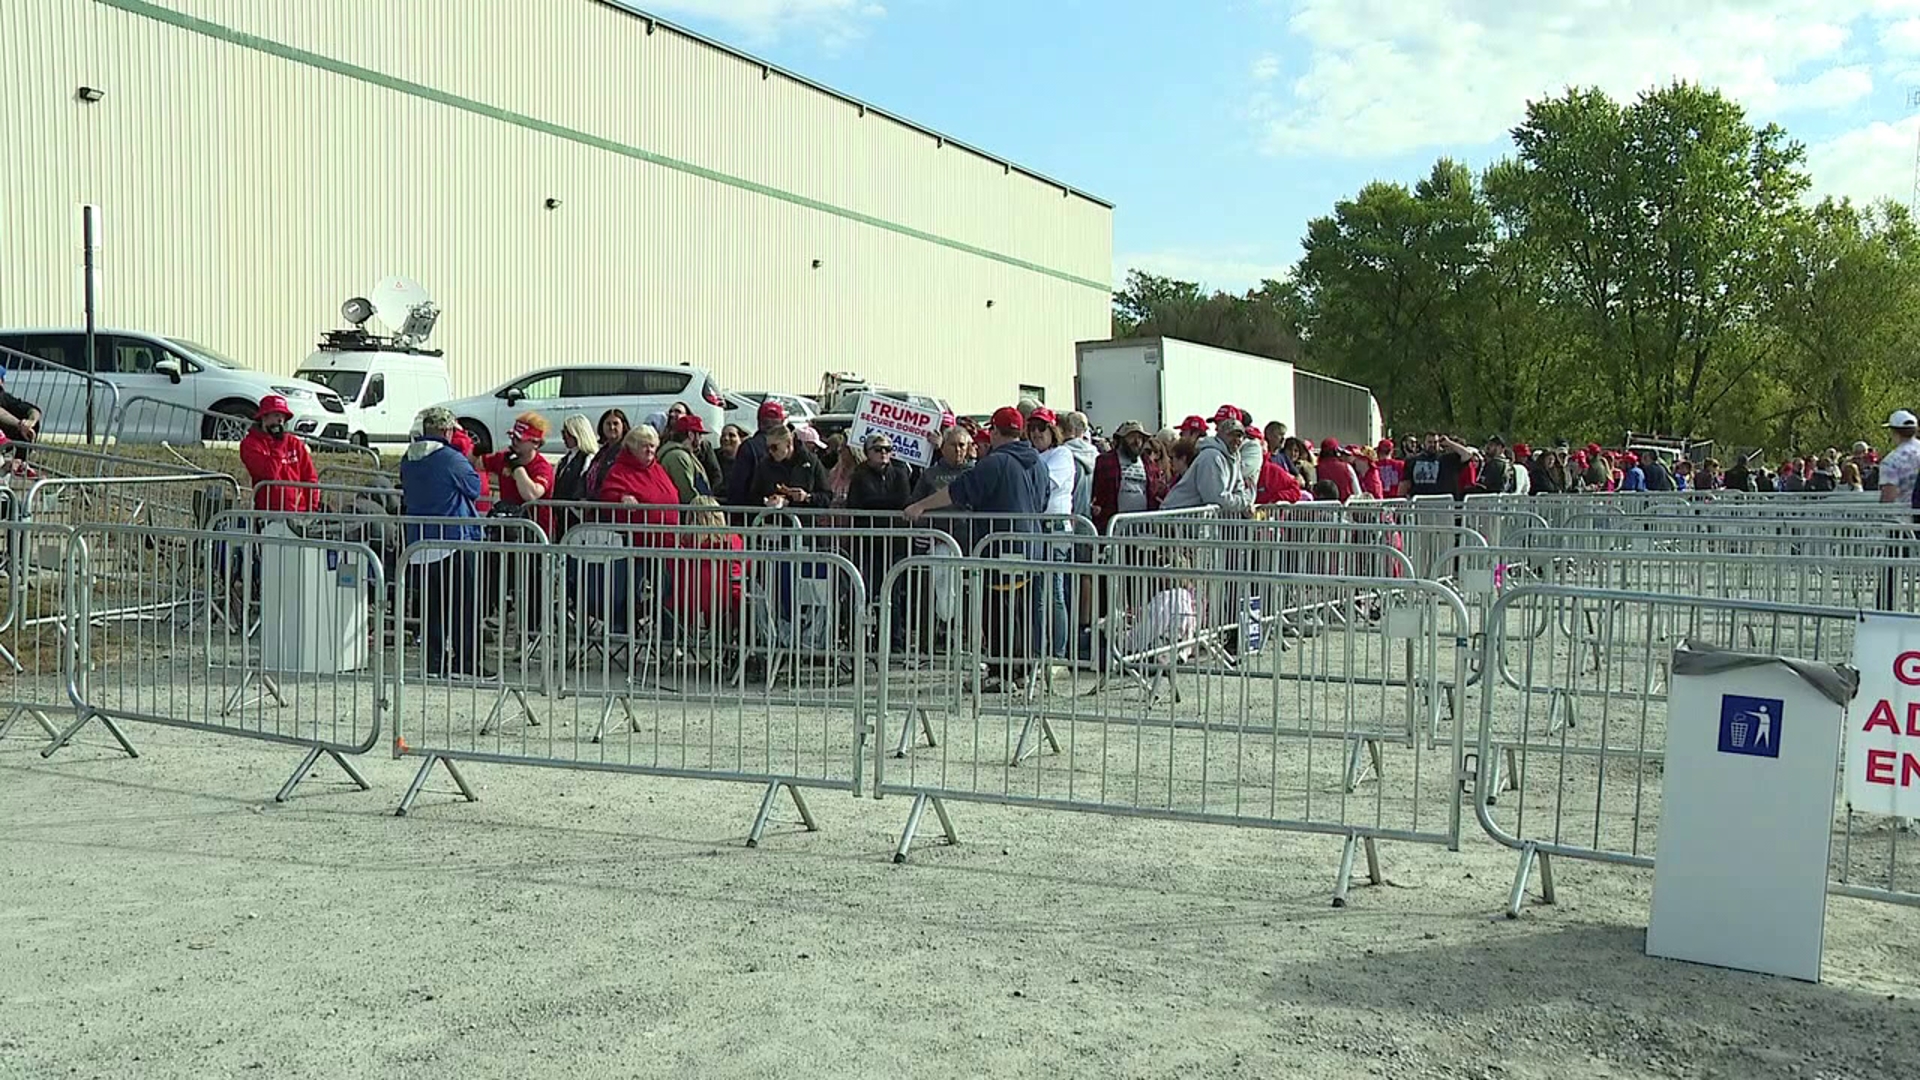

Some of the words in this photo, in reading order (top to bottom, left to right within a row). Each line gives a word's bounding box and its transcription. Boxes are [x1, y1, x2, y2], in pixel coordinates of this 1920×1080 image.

[860, 412, 895, 428] SECURE
[870, 400, 931, 427] TRUMP
[865, 426, 919, 451] KMALA
[891, 444, 922, 459] ORDER
